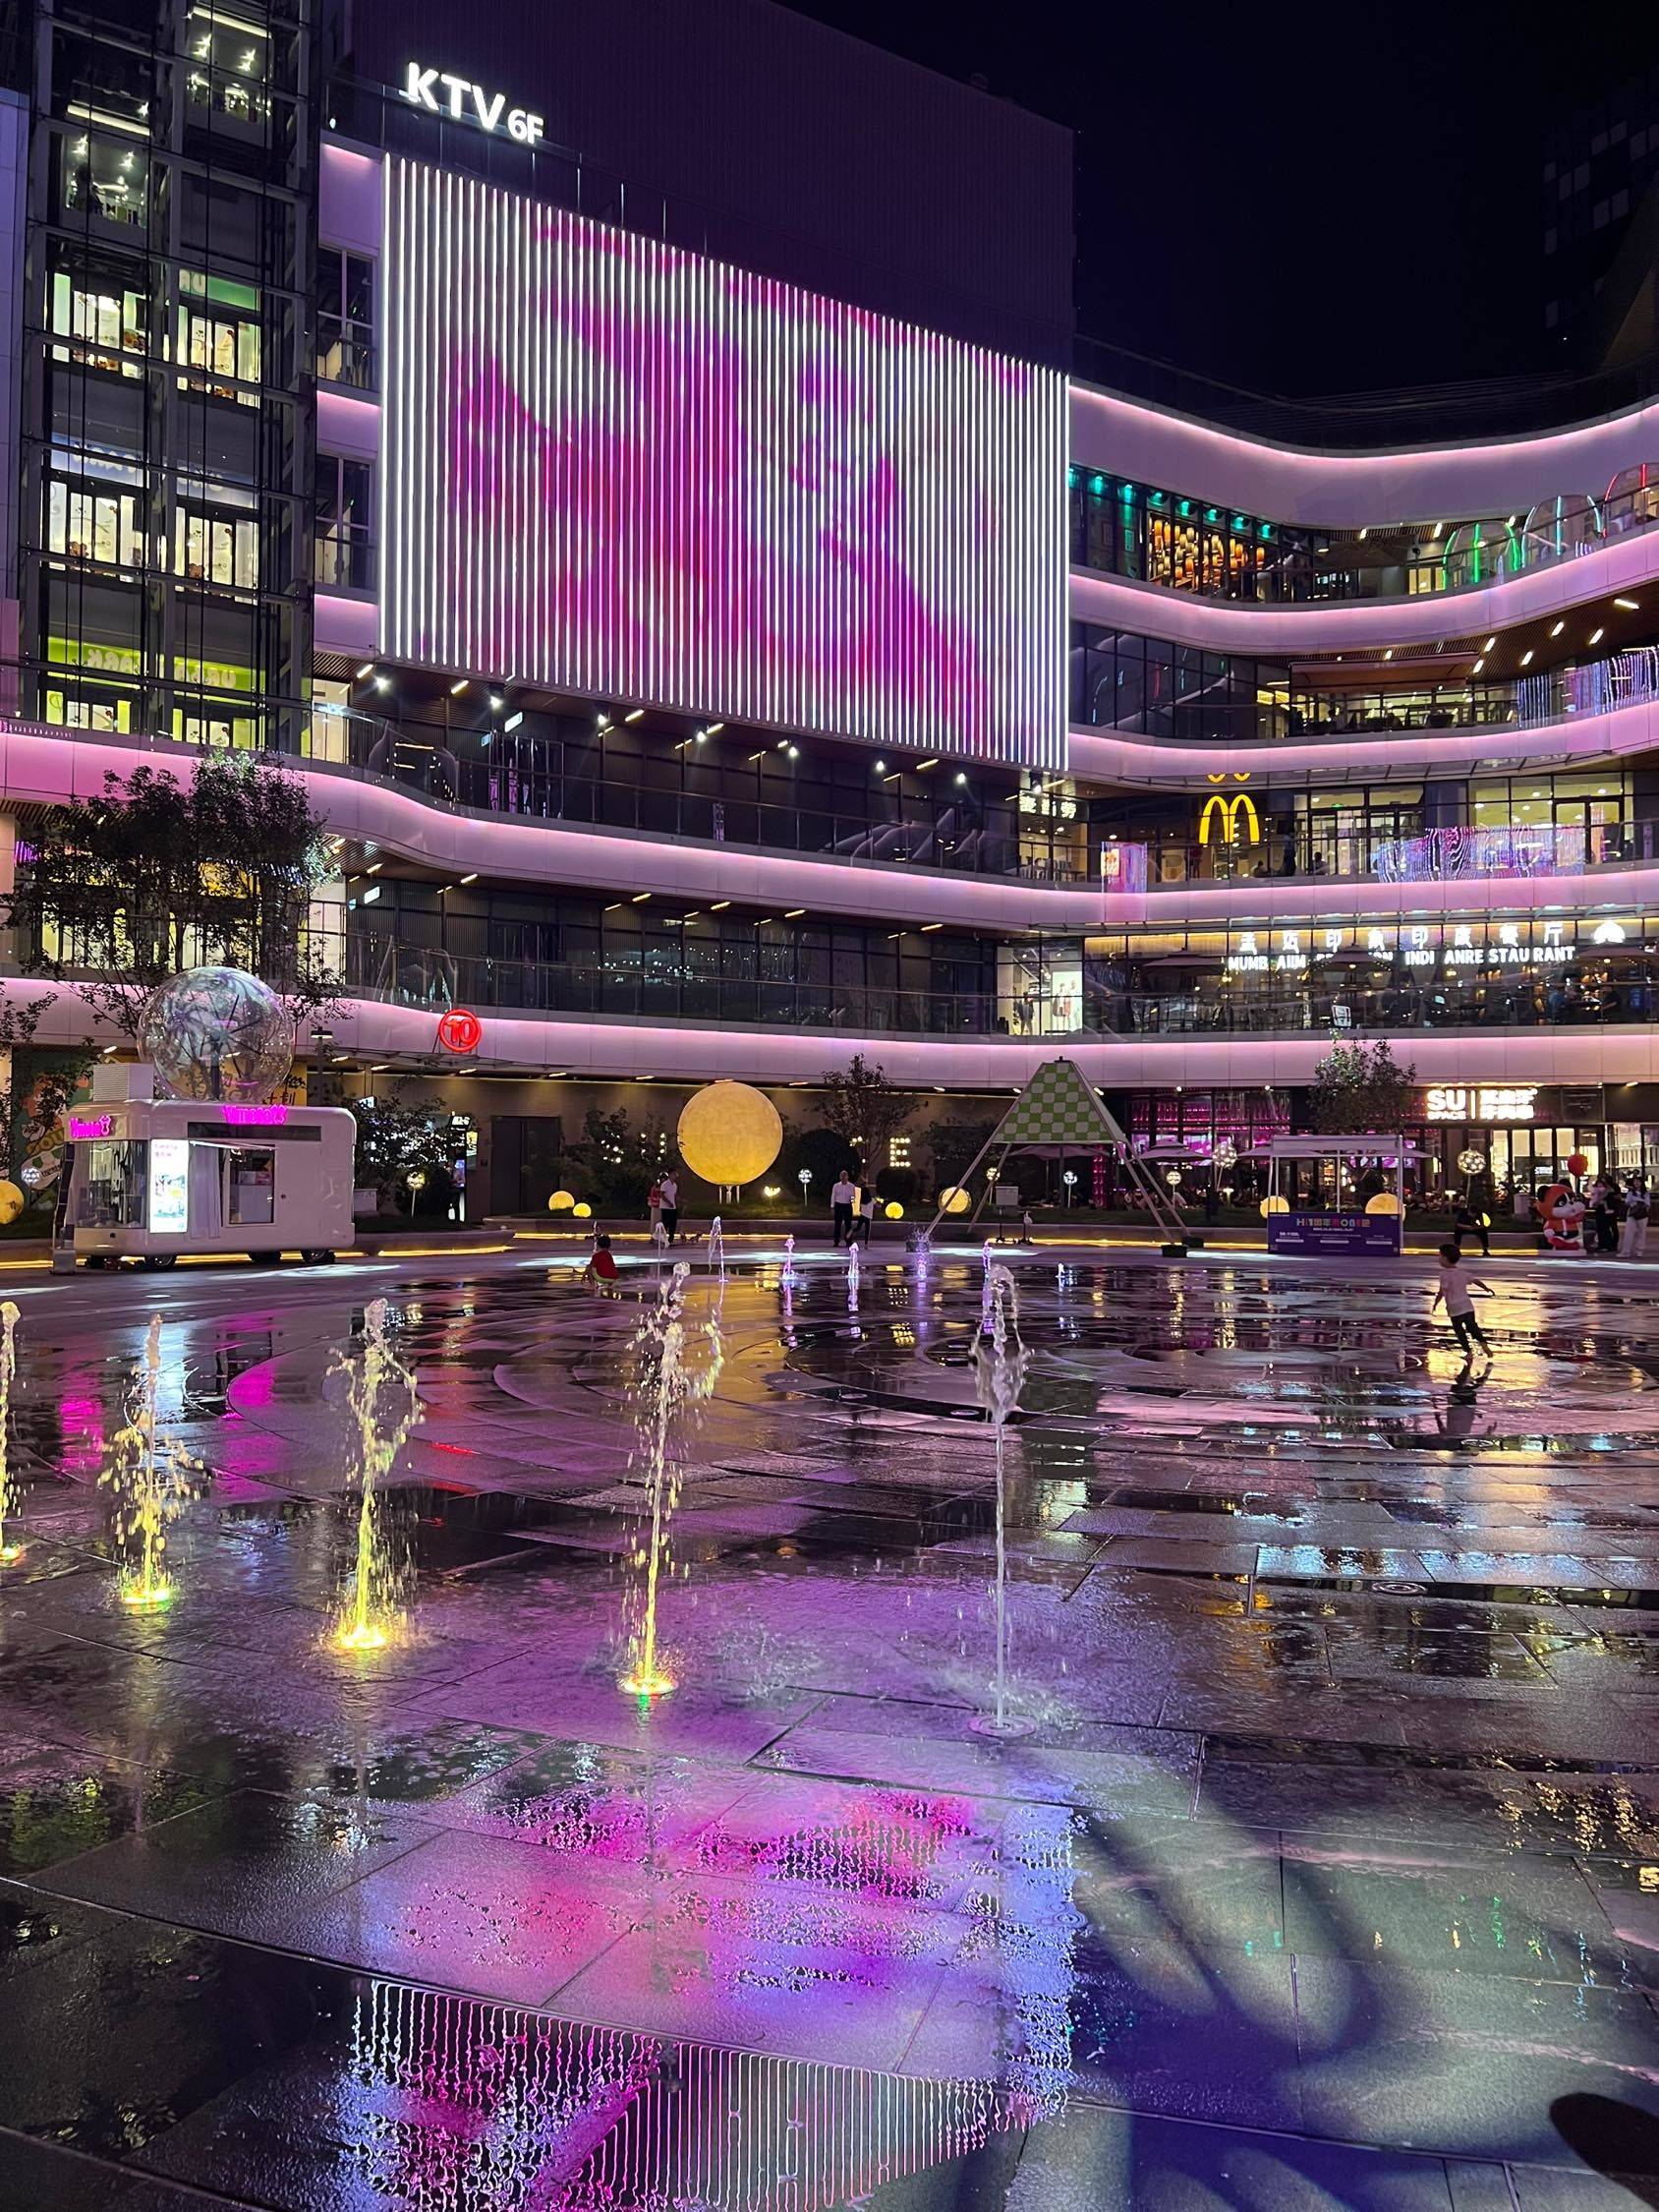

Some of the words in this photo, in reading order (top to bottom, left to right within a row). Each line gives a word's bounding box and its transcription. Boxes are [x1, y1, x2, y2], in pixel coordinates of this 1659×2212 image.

[408, 61, 506, 130] KTV
[507, 108, 544, 144] 6F
[446, 1018, 477, 1044] 10
[1427, 1089, 1466, 1111] SU
